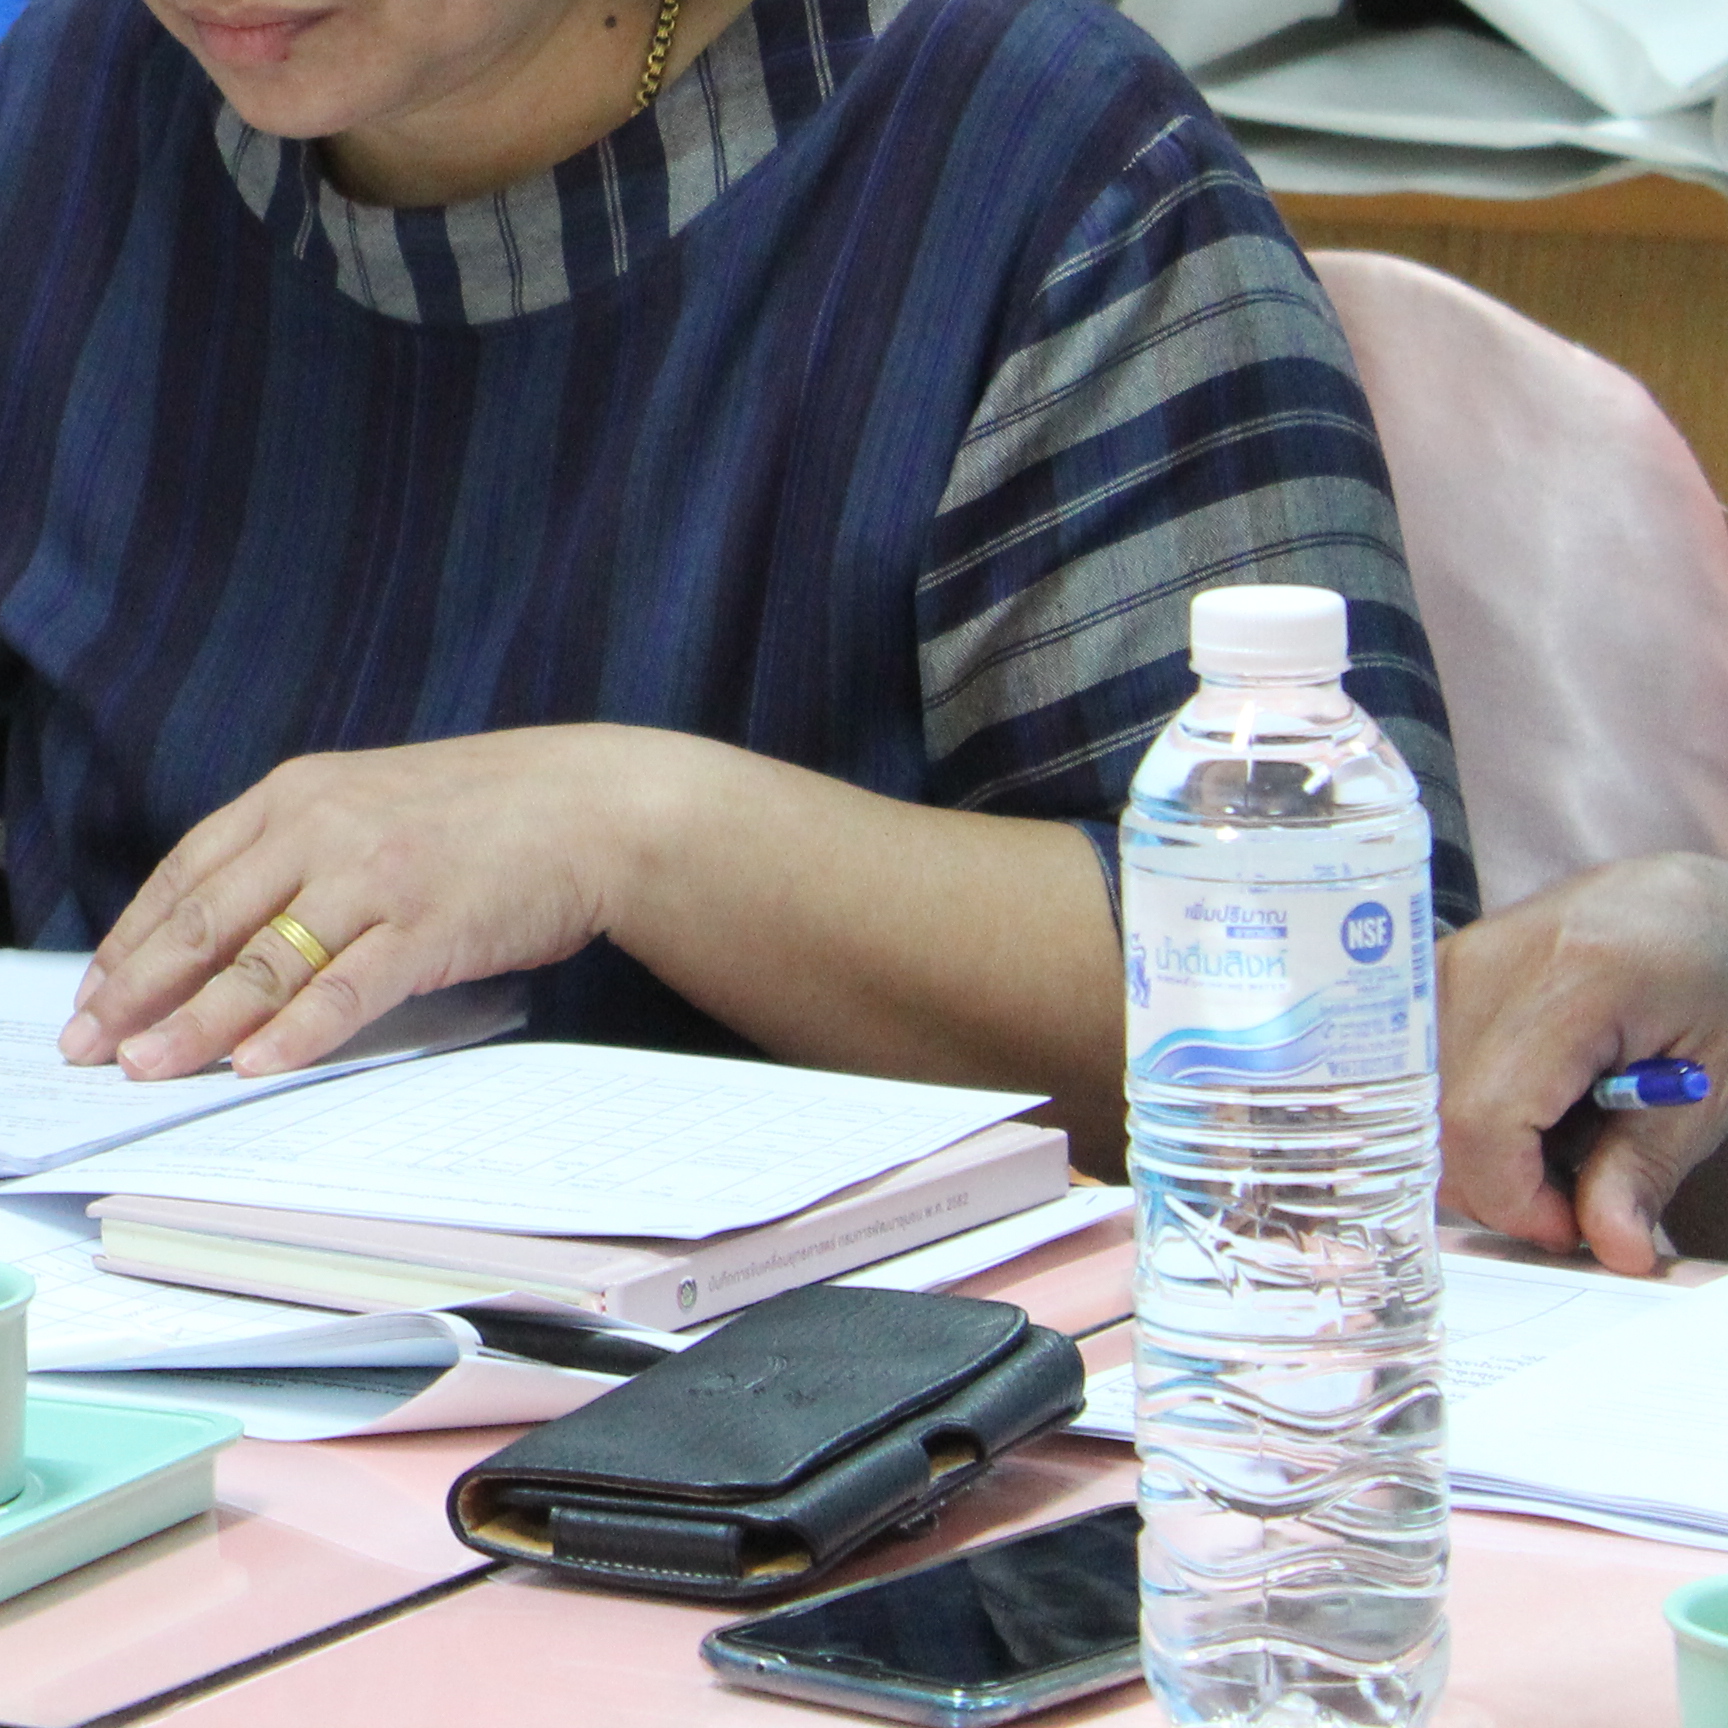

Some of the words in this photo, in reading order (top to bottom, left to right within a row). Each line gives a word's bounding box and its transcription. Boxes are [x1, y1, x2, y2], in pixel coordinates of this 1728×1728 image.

[1184, 898, 1287, 924] เพิ่มปริมาณ
[1348, 916, 1389, 949] NSF
[1155, 936, 1288, 978] น้ำดื่มสิงห์
